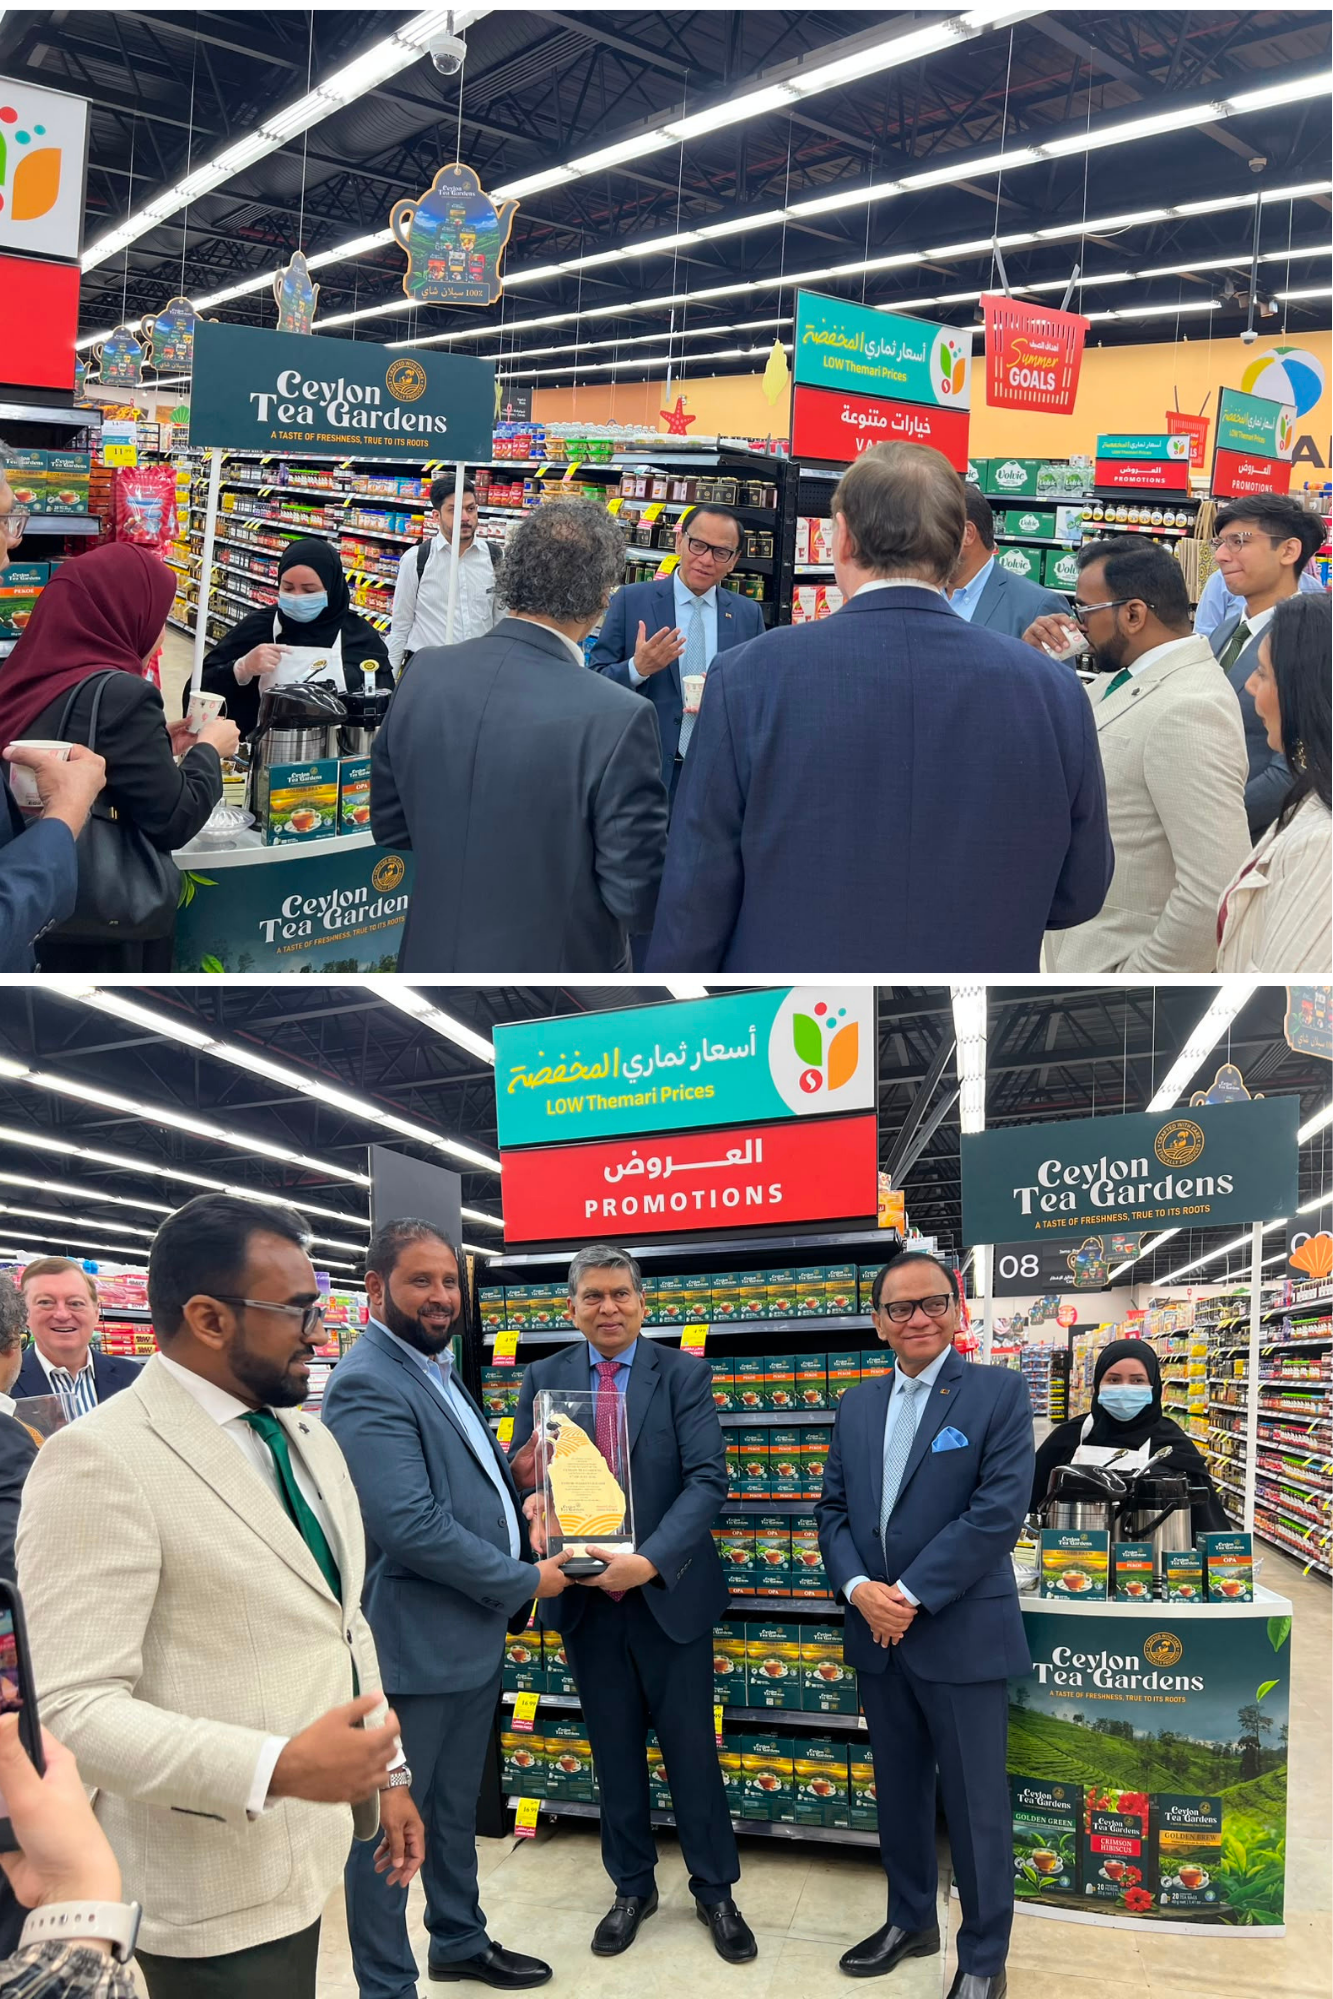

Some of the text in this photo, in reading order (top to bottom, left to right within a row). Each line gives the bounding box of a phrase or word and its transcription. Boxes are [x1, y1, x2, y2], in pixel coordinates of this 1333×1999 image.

[422, 286, 438, 299] شاي
[441, 287, 464, 297] سيلان
[803, 318, 926, 362] أسعار ثماري المخفضة
[1006, 338, 1059, 368] Summer
[823, 355, 907, 382] LOW Themari Prices
[1009, 367, 1055, 391] GOALS
[276, 370, 380, 406] Ceylon
[250, 392, 447, 433] Tea Gardens
[840, 404, 931, 438] خيارات متنوعة
[270, 431, 429, 447] A TASTE OF FRESHNESS, TRUE TO ITS ROOTS
[997, 466, 1025, 481] Volvic
[1232, 480, 1273, 493] PROMOTIONS
[1020, 518, 1039, 526] Volvic
[1001, 558, 1028, 570] Volvic
[282, 886, 368, 918] Ceylon
[259, 894, 408, 943] Tea Garden
[282, 943, 303, 953] TASTE
[314, 931, 352, 946] FRESHNESS,
[352, 927, 368, 935] TRUE
[377, 922, 387, 930] ITS
[387, 916, 405, 926] ROOTS
[507, 1025, 757, 1094] أسعار ثماري المخفضة
[546, 1084, 715, 1116] LOW Themari Prices
[1158, 1123, 1176, 1144] CRAFTED
[1038, 1156, 1149, 1189] Ceylon
[584, 1182, 784, 1219] PROMOTIONS
[1013, 1174, 1234, 1215] Tea Gardens
[1035, 1204, 1210, 1229] A TASTE OF FRESHNESS, TRUE TO ITS ROOTS
[998, 1254, 1040, 1278] 08
[1052, 1646, 1140, 1673] Ceylon
[1032, 1662, 1204, 1691] Tea Gardens
[1085, 1692, 1124, 1701] FRESHNESS,
[1125, 1694, 1141, 1702] TRUE
[1017, 1794, 1034, 1804] Tea
[1037, 1797, 1071, 1809] Gardens
[1023, 1788, 1052, 1800] Ceylon
[1015, 1813, 1073, 1826] GOLDEN GREEN
[1165, 1812, 1217, 1824] Tea Gardens
[1171, 1806, 1199, 1816] Ceylon
[1093, 1822, 1107, 1830] Tea
[1109, 1825, 1140, 1835] Gardens
[1098, 1817, 1122, 1827] Ceylon
[1100, 1838, 1132, 1847] CRIMSON
[1165, 1832, 1195, 1840] GOLDEN
[1101, 1844, 1132, 1854] HIBISCUS
[1097, 1883, 1104, 1891] 20
